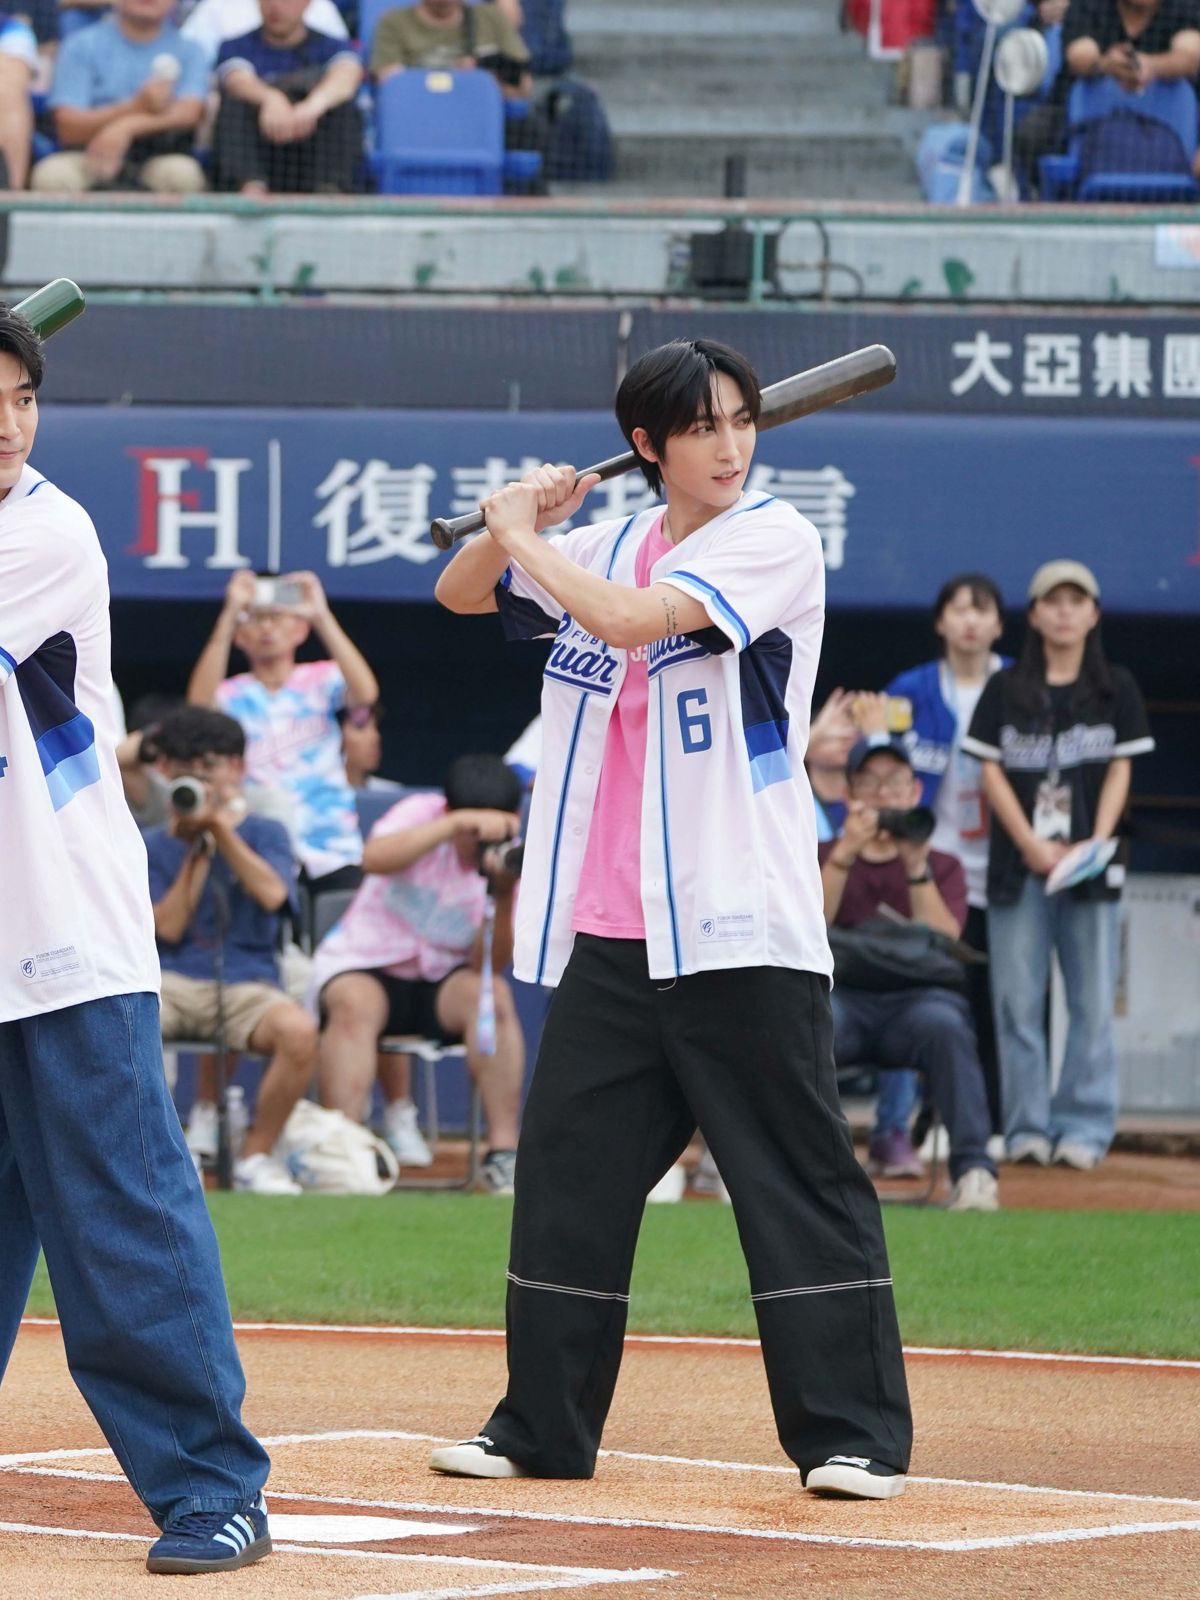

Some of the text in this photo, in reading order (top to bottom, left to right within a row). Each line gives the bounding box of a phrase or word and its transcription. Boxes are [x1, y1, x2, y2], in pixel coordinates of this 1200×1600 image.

[951, 331, 1200, 398] 大亞集團
[572, 630, 600, 645] FUB
[677, 688, 712, 755] 6
